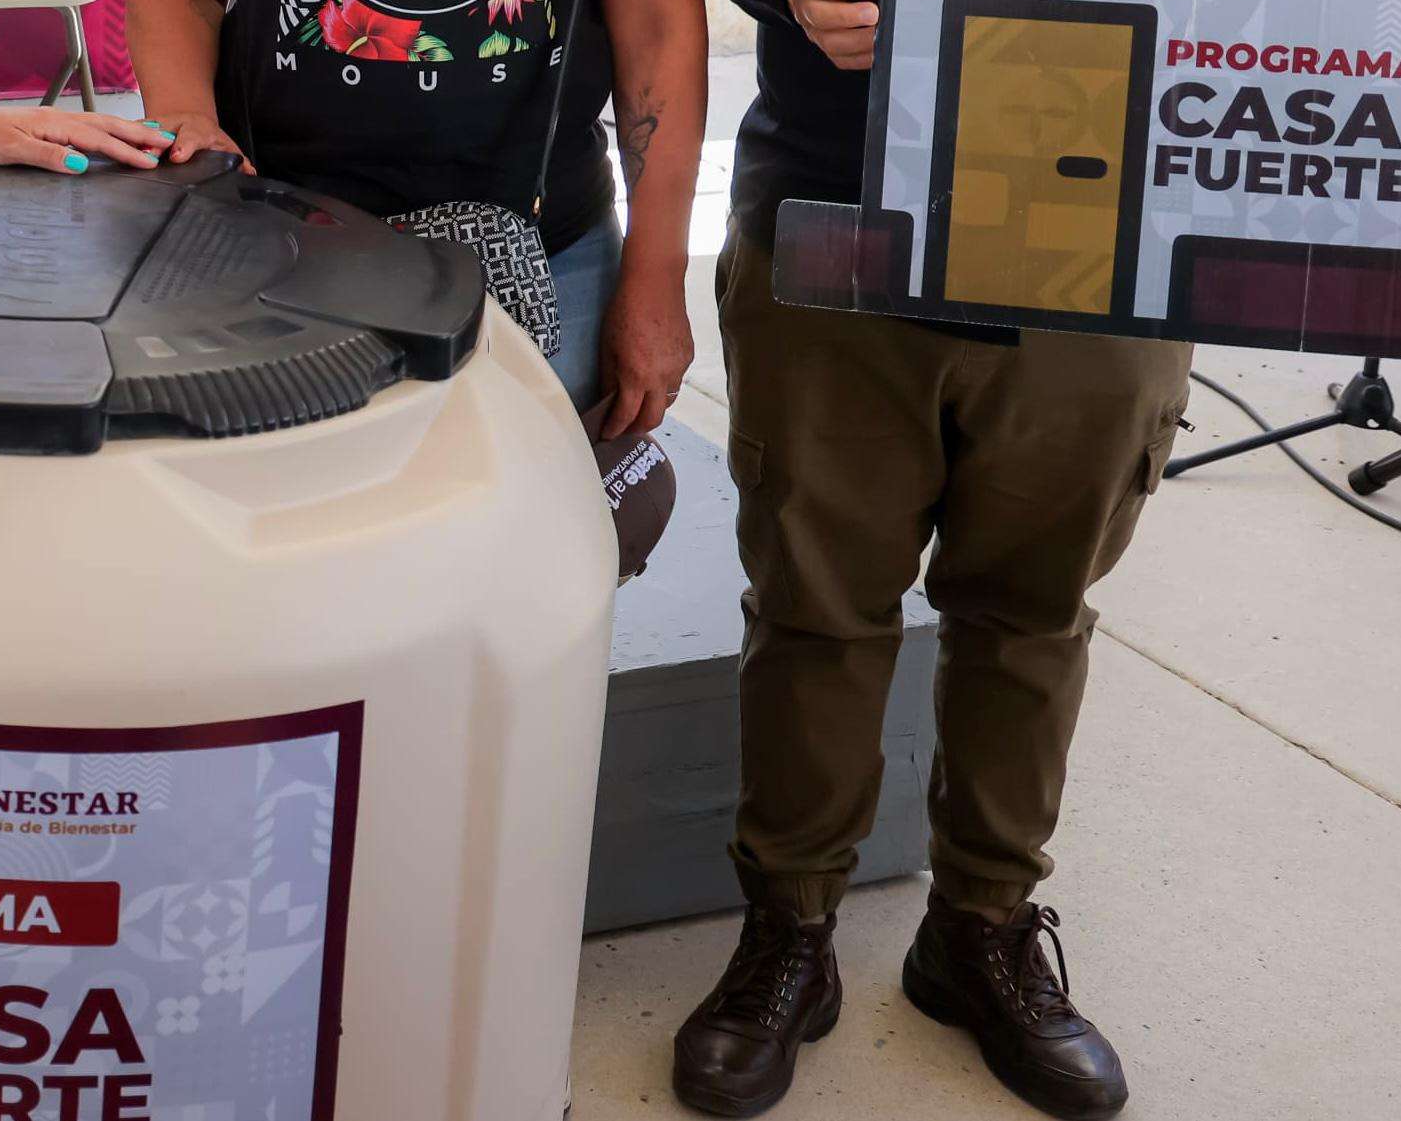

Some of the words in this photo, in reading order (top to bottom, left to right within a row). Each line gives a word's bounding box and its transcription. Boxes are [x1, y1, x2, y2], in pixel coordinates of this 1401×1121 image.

[276, 45, 564, 92] MOUSE
[1166, 39, 1401, 78] PROGRAM
[1158, 82, 1401, 149] CASA
[1153, 144, 1401, 202] FUERTE
[19, 820, 42, 834] de
[49, 821, 138, 836] Bienestar
